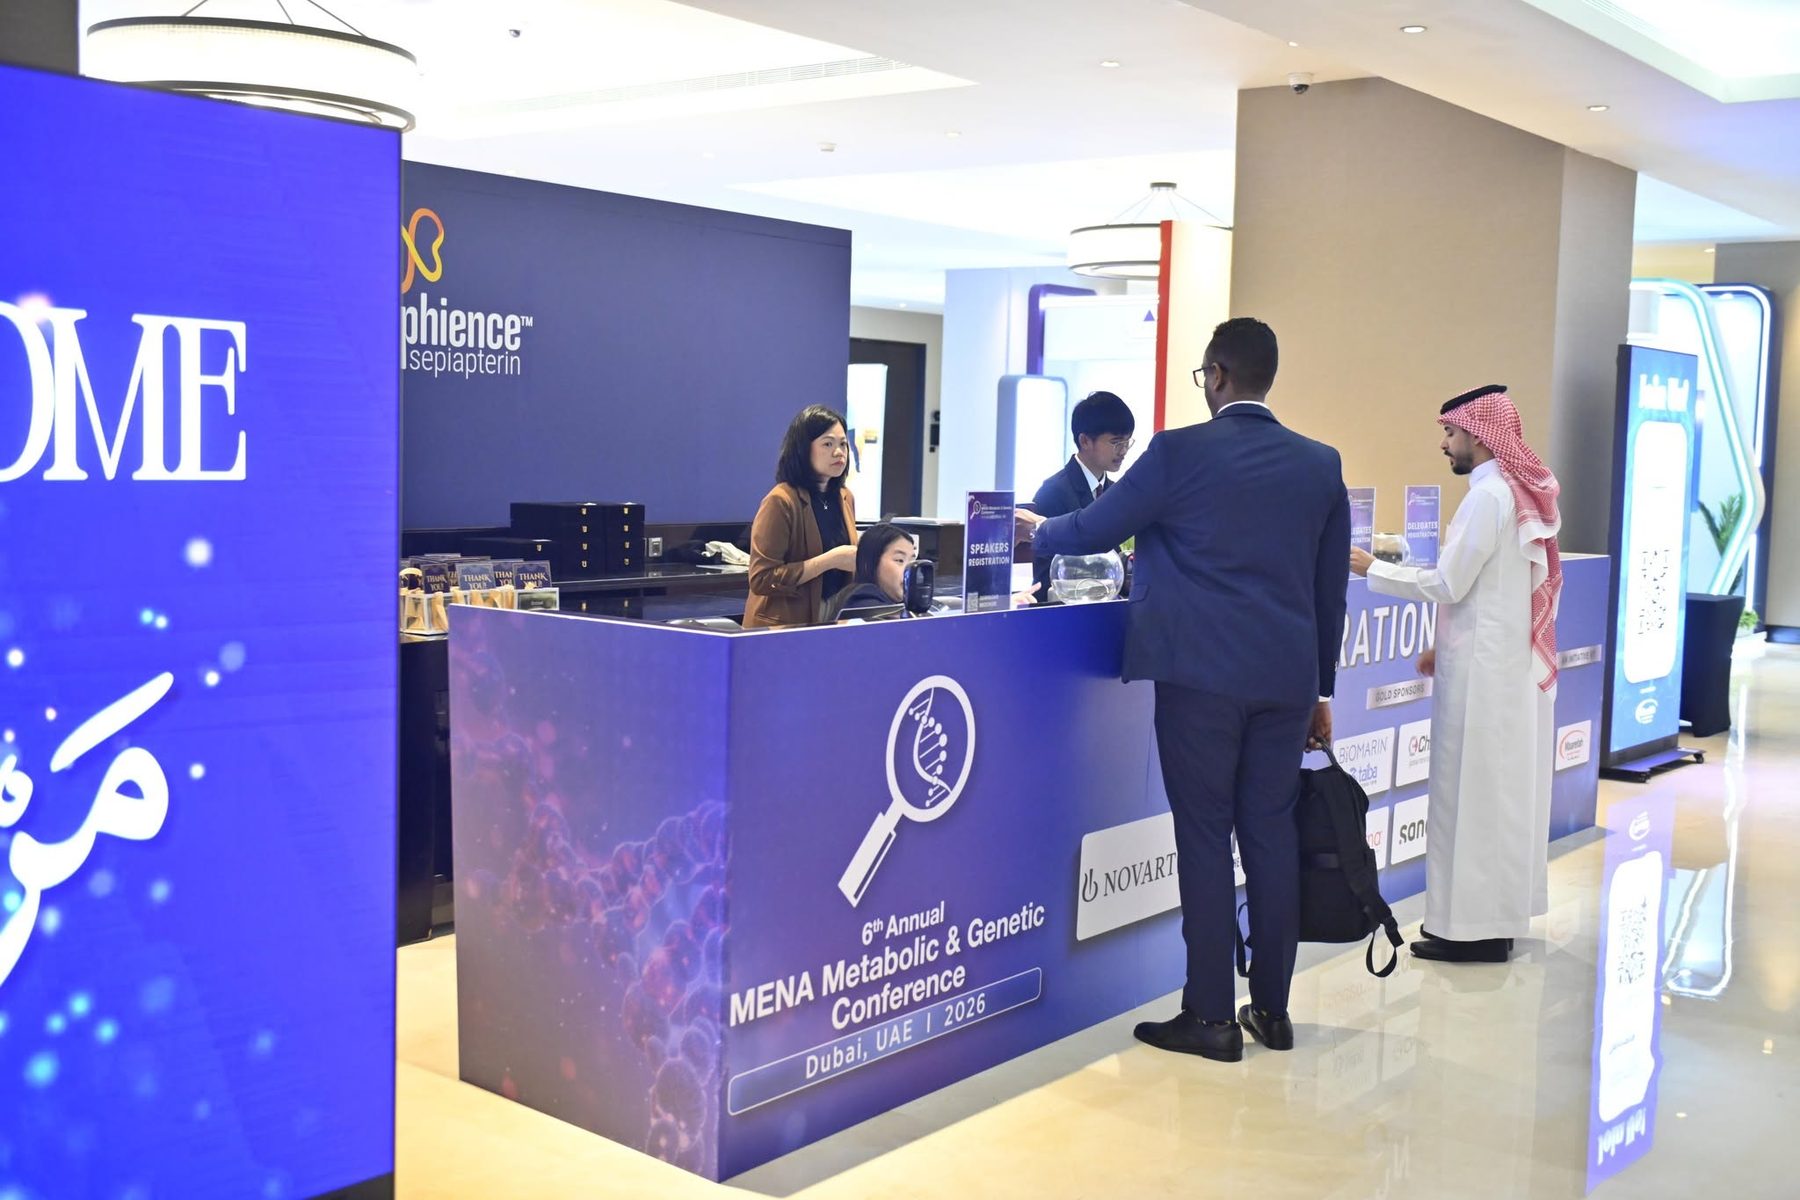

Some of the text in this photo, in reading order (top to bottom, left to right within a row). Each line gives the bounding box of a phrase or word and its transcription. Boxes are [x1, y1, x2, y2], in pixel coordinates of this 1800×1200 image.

[409, 348, 521, 379] sepiapterin
[970, 542, 1009, 555] SPEAKERS
[968, 556, 1010, 567] REGISTRATION
[426, 575, 448, 584] THANK
[462, 574, 493, 583] THANK
[518, 572, 549, 581] THANK
[1375, 683, 1425, 702] GOLD SPONSORS
[1398, 819, 1428, 844] san
[1103, 852, 1177, 897] NOVART
[861, 900, 945, 946] 6th Annual
[729, 901, 1045, 1028] MENA Metabolic & Genetic
[831, 965, 966, 1031] Conference
[805, 1037, 868, 1080] Dubai,
[876, 1019, 913, 1052] UAE
[943, 993, 987, 1027] 2026
